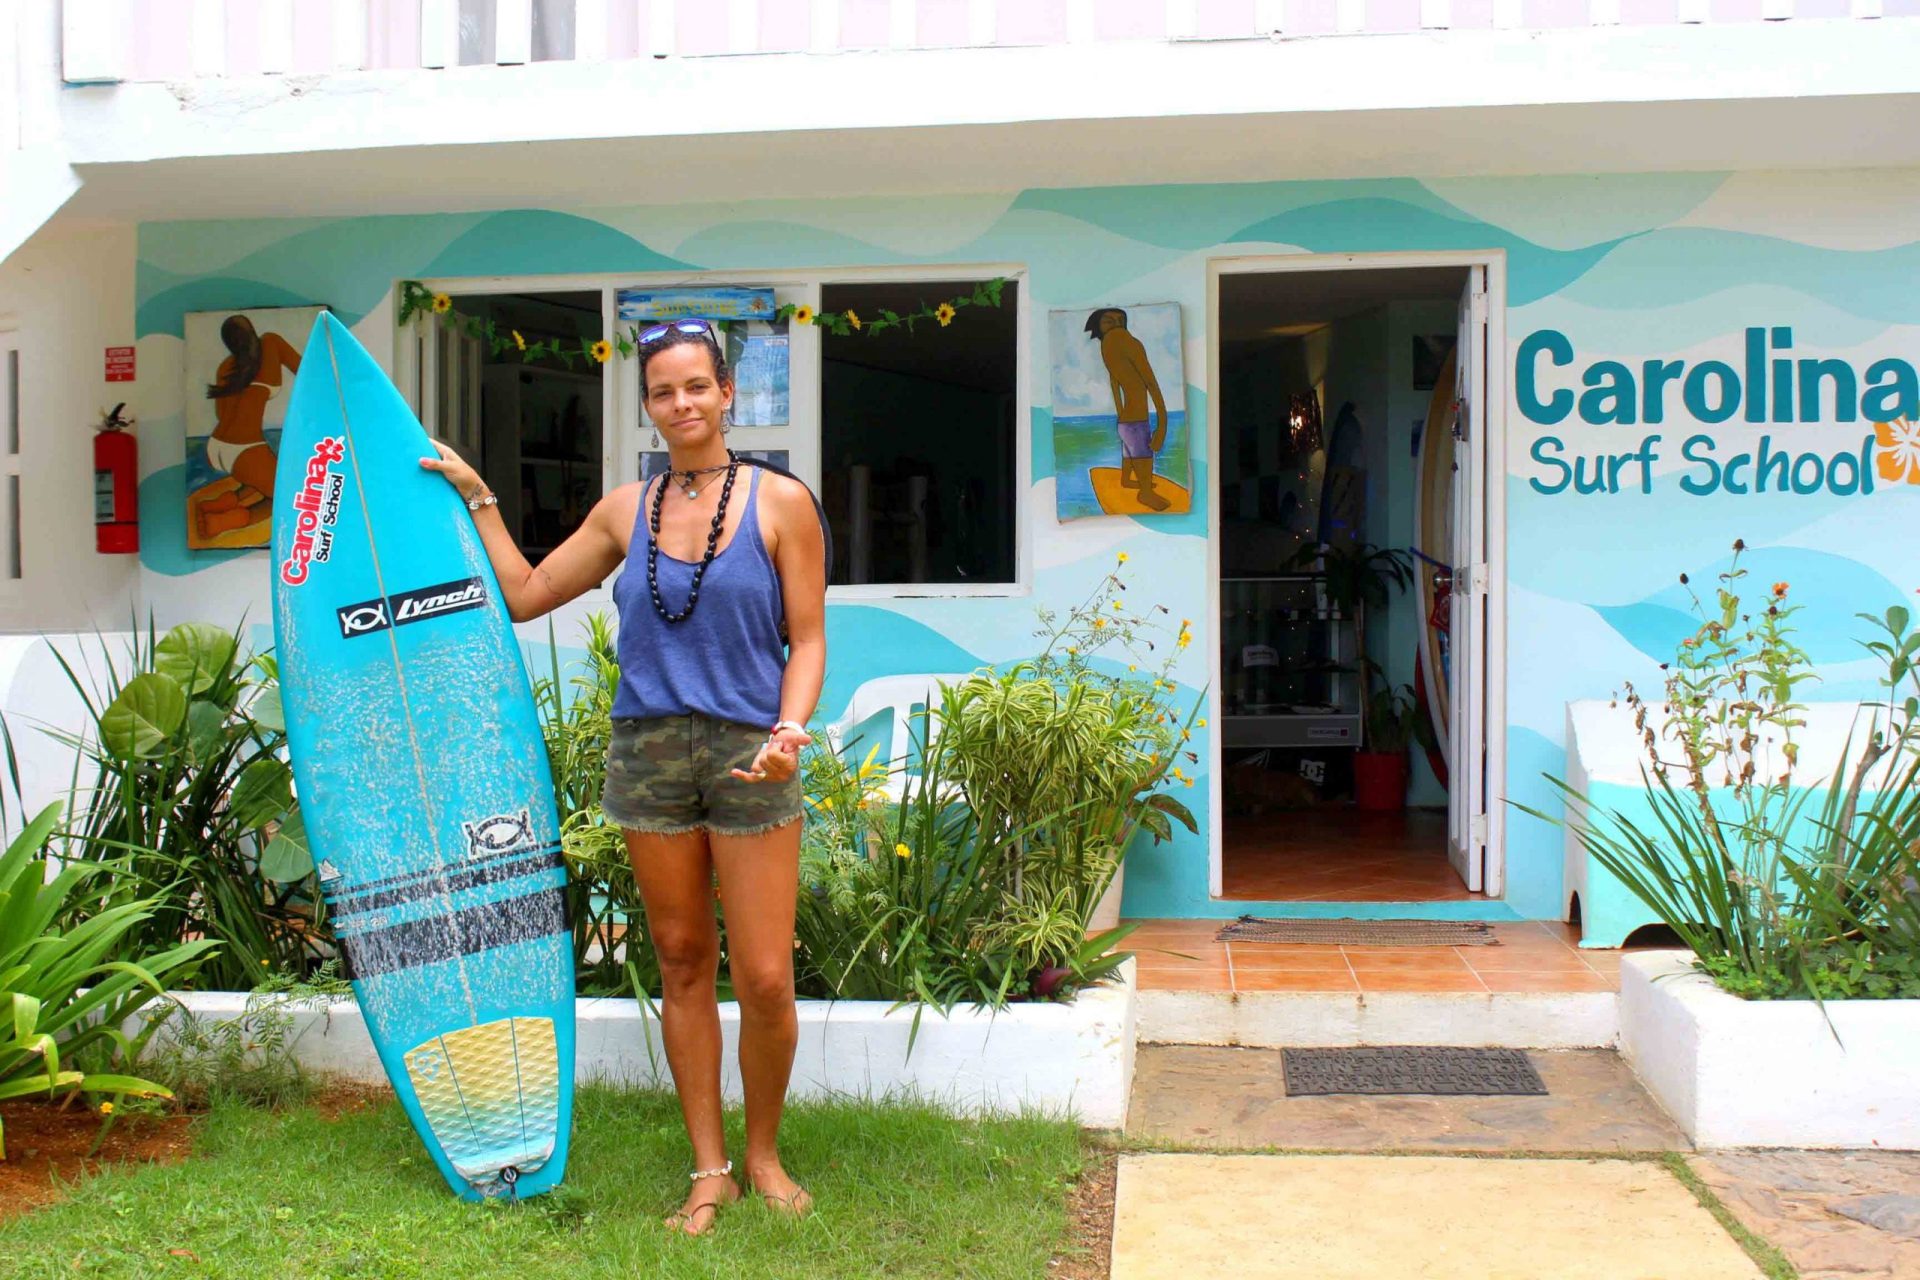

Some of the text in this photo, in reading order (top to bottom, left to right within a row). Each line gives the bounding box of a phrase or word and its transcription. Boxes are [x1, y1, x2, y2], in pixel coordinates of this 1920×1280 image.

[1515, 327, 1919, 425] Carolina
[1529, 434, 1875, 496] Surf School
[282, 456, 328, 585] Carolina
[316, 474, 343, 562] Surf School
[395, 584, 482, 621] Lynch
